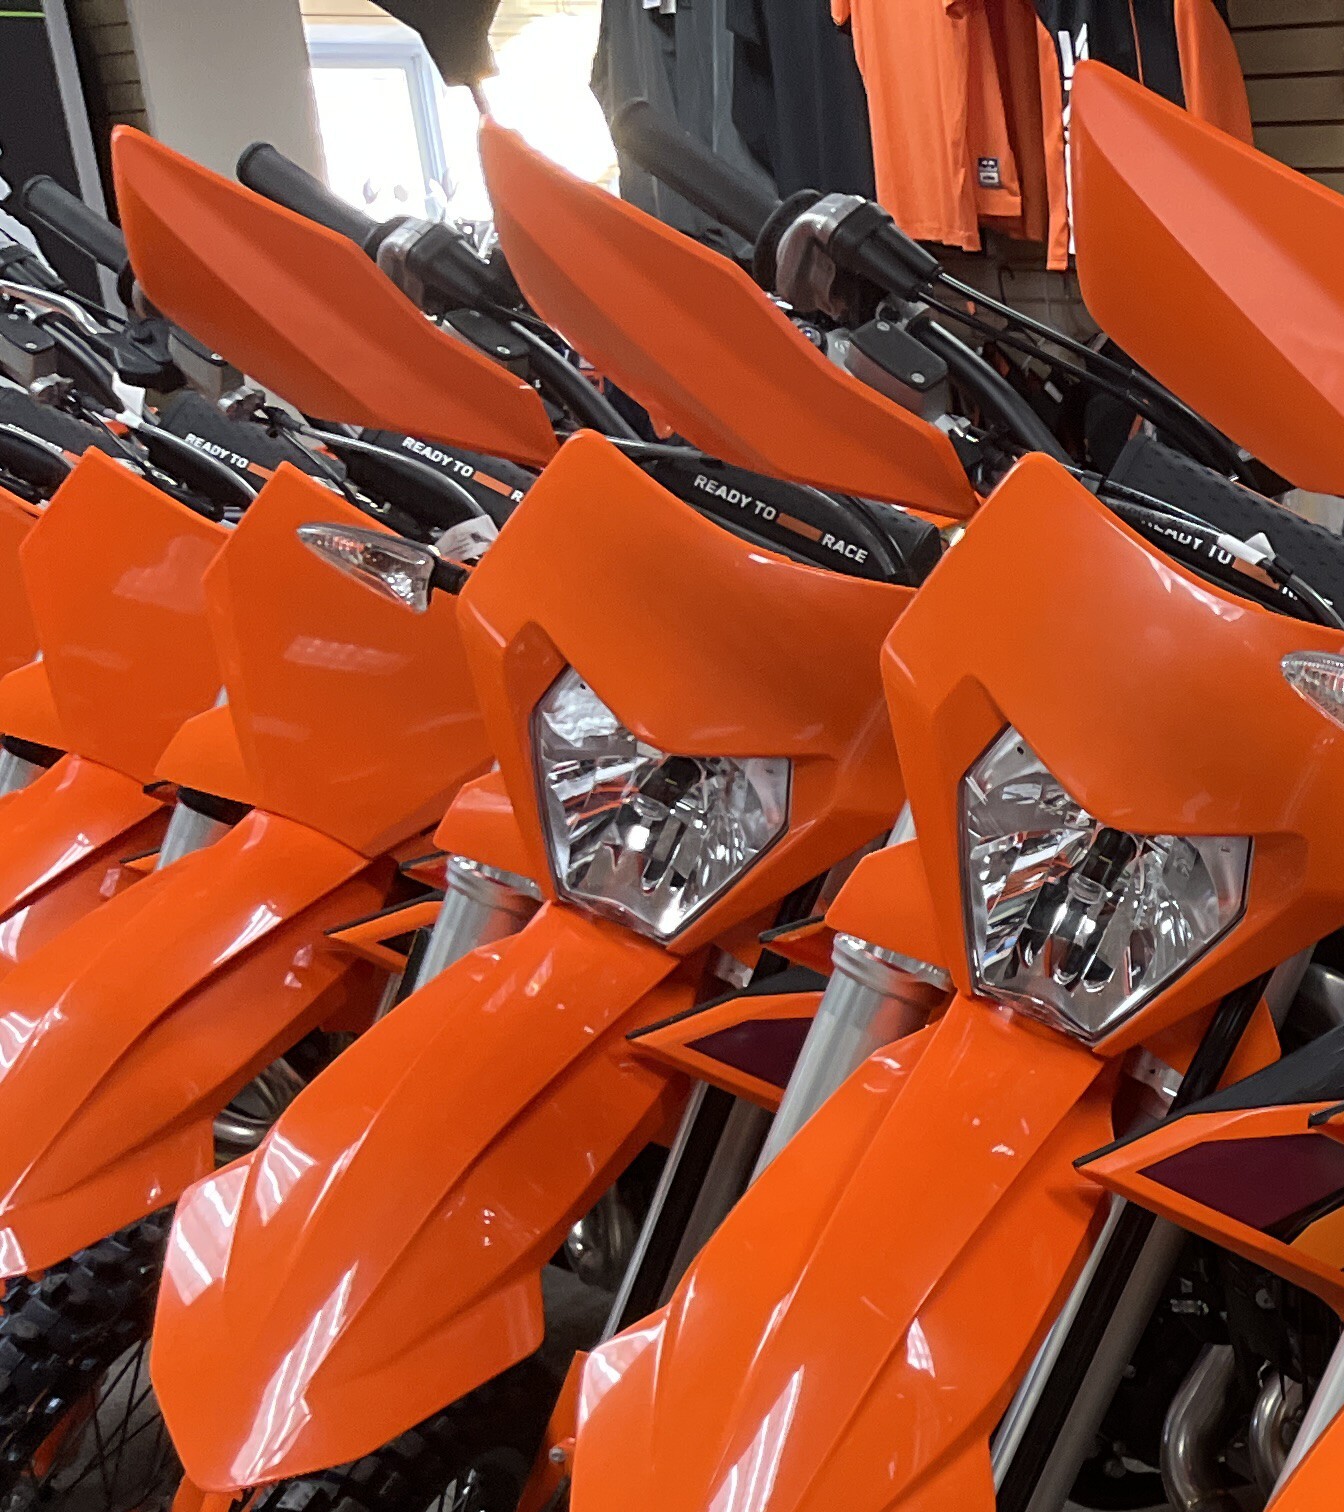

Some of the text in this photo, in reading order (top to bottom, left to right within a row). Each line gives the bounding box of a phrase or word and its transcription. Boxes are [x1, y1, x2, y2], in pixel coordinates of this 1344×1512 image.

[185, 433, 249, 469] READY TO
[402, 436, 474, 477] READY TO
[694, 474, 869, 565] READY TO RACE
